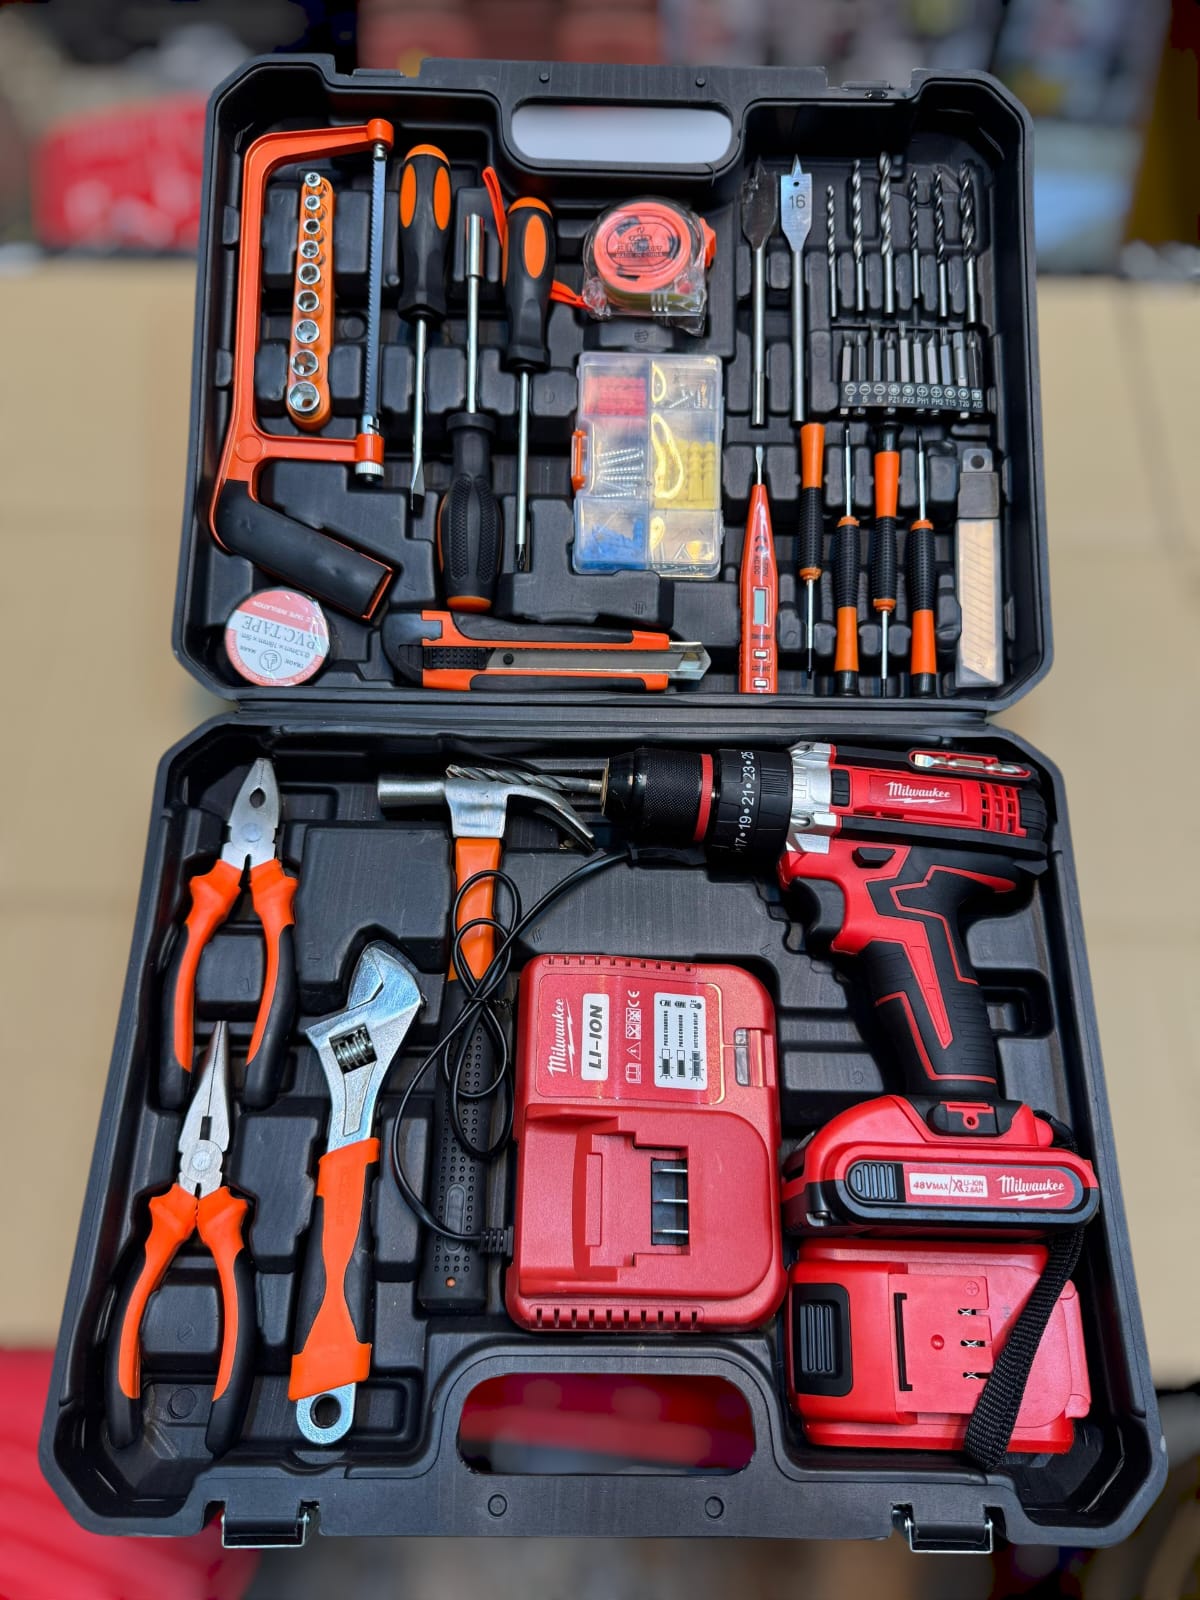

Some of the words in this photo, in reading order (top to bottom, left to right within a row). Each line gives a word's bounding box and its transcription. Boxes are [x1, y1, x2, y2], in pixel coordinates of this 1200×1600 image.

[789, 194, 806, 210] 16
[847, 395, 853, 403] 4
[862, 395, 868, 403] 5
[888, 396, 900, 404] PZ1
[959, 400, 970, 408] T20
[740, 751, 755, 760] 25
[742, 765, 756, 781] 23
[884, 781, 953, 798] Milwaukee
[741, 790, 755, 806] 21
[738, 815, 752, 830] 19
[547, 998, 568, 1078] Milwaukee
[588, 1004, 603, 1070] LI-ION
[996, 1175, 1065, 1194] Milwaukee
